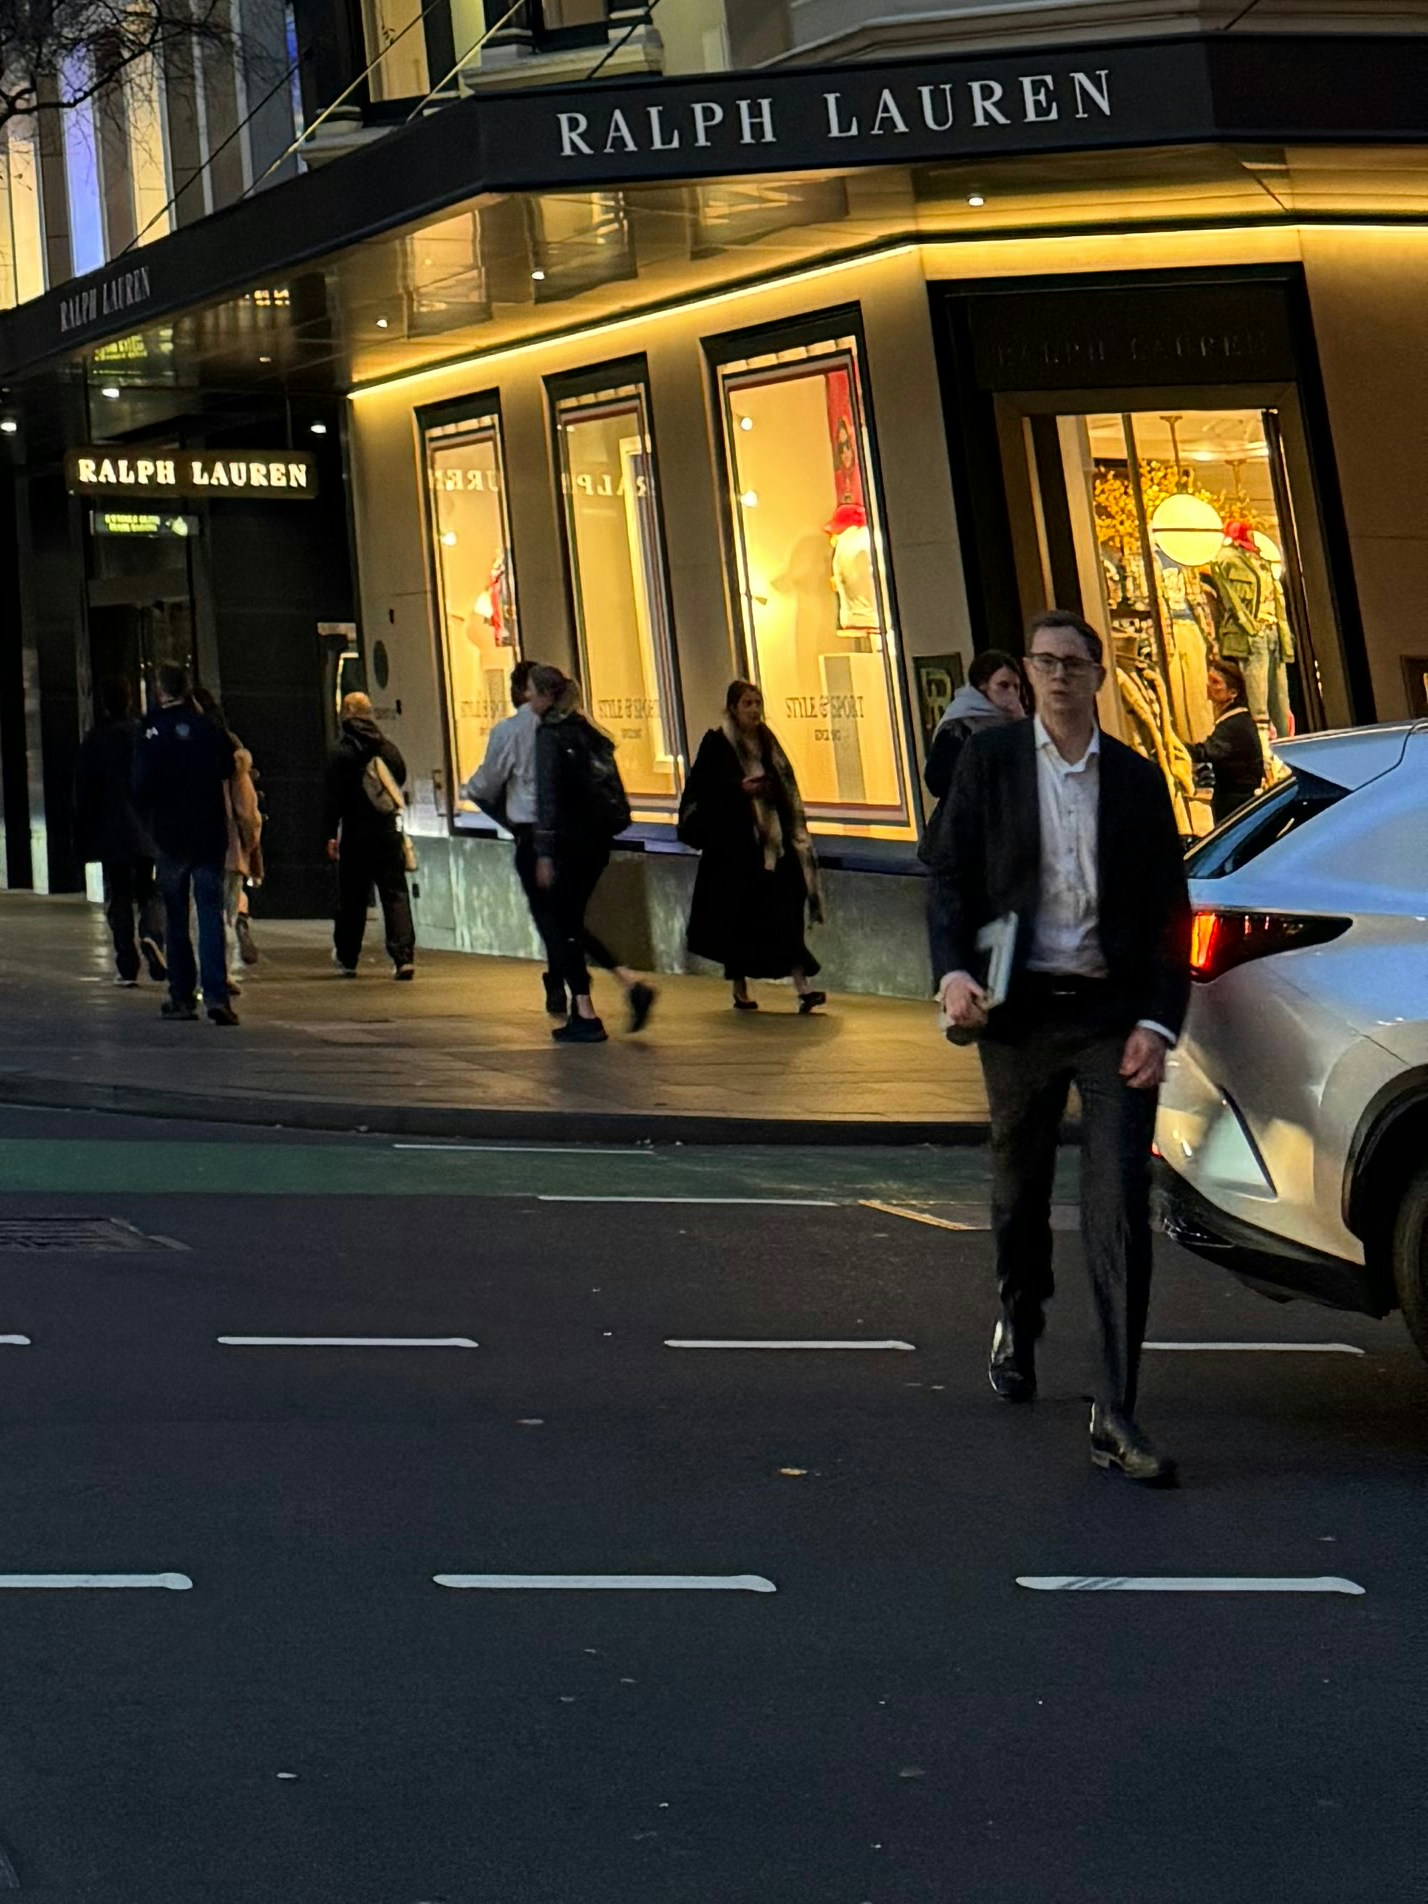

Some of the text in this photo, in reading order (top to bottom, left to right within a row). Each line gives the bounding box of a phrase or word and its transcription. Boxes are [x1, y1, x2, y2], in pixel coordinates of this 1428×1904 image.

[556, 69, 1113, 157] RALPH LAUREN
[60, 266, 151, 333] RALPH LAUREN
[78, 458, 307, 488] RALPH LAUREN
[785, 696, 818, 719] STYLE
